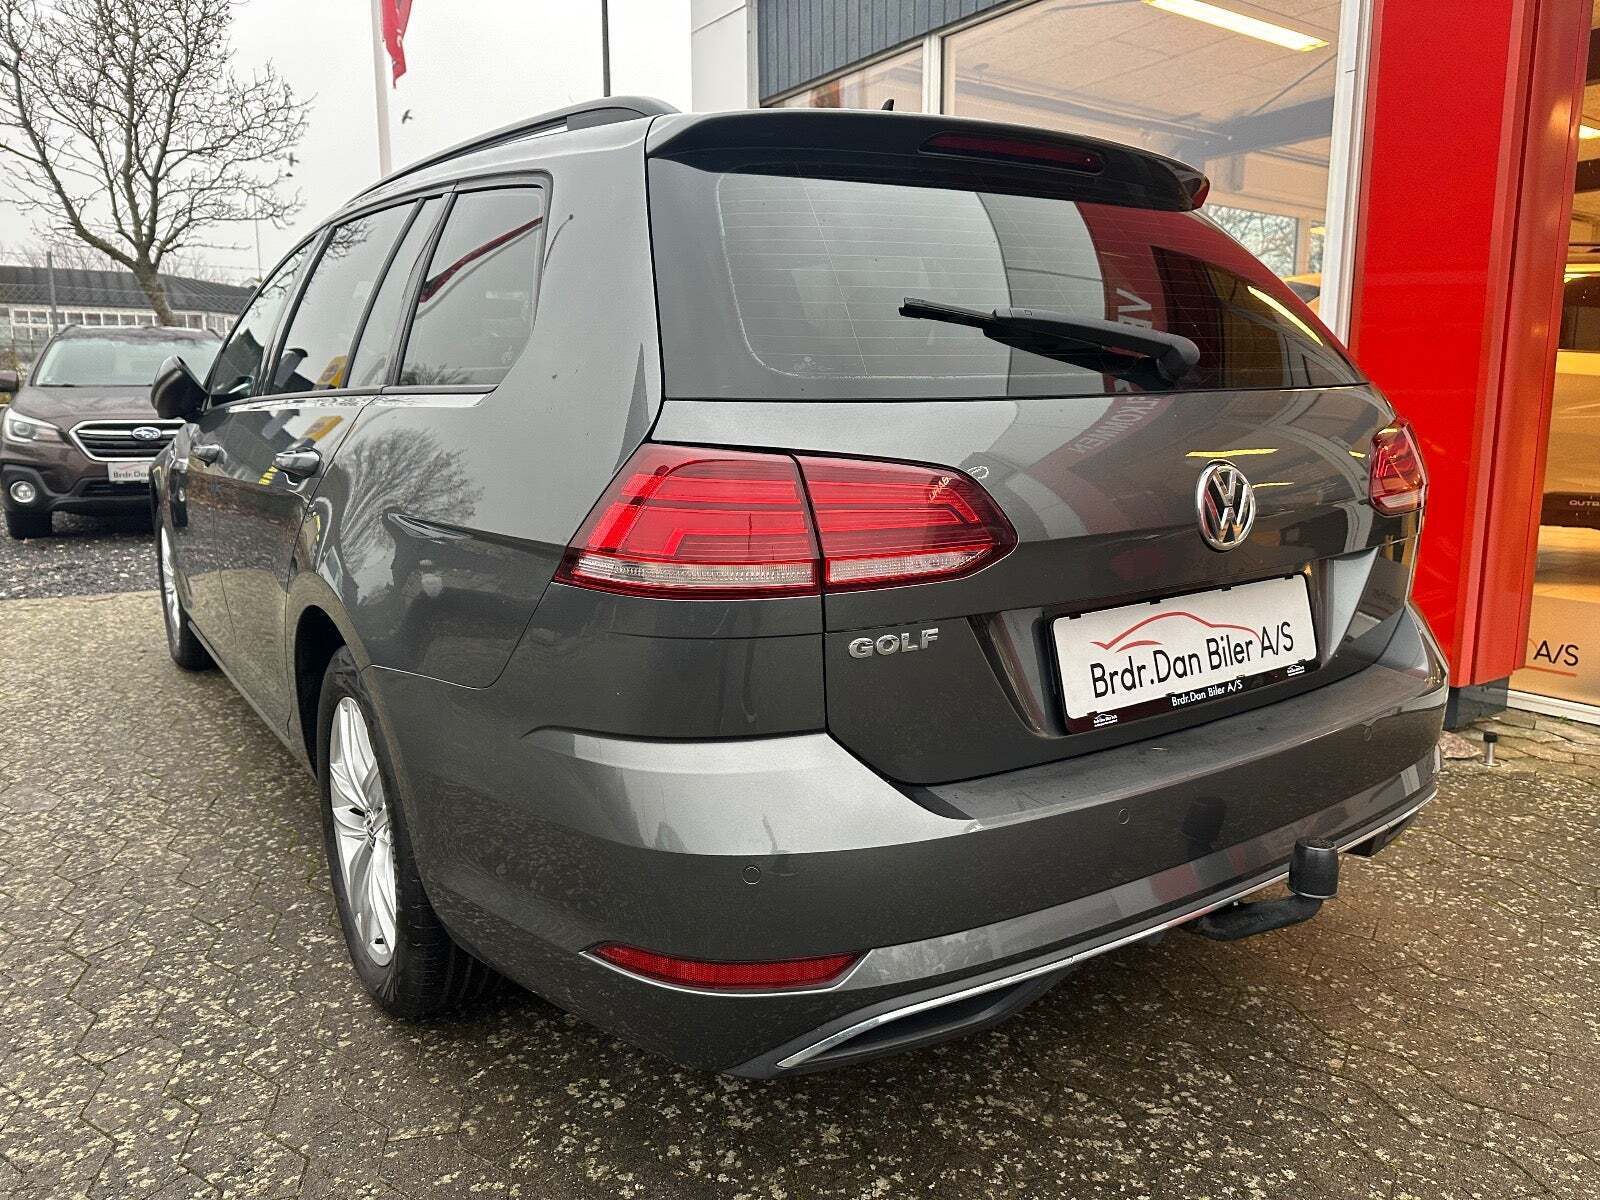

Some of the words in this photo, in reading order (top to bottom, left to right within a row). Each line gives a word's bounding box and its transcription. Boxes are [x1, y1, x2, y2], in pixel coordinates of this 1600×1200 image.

[848, 627, 939, 659] GOLF
[1533, 639, 1579, 667] A/S
[1090, 649, 1202, 698] Brdr.Dan
[1206, 634, 1253, 671] Biler
[1260, 621, 1294, 659] A/S
[1207, 684, 1226, 697] Biler
[1227, 679, 1243, 693] A/S
